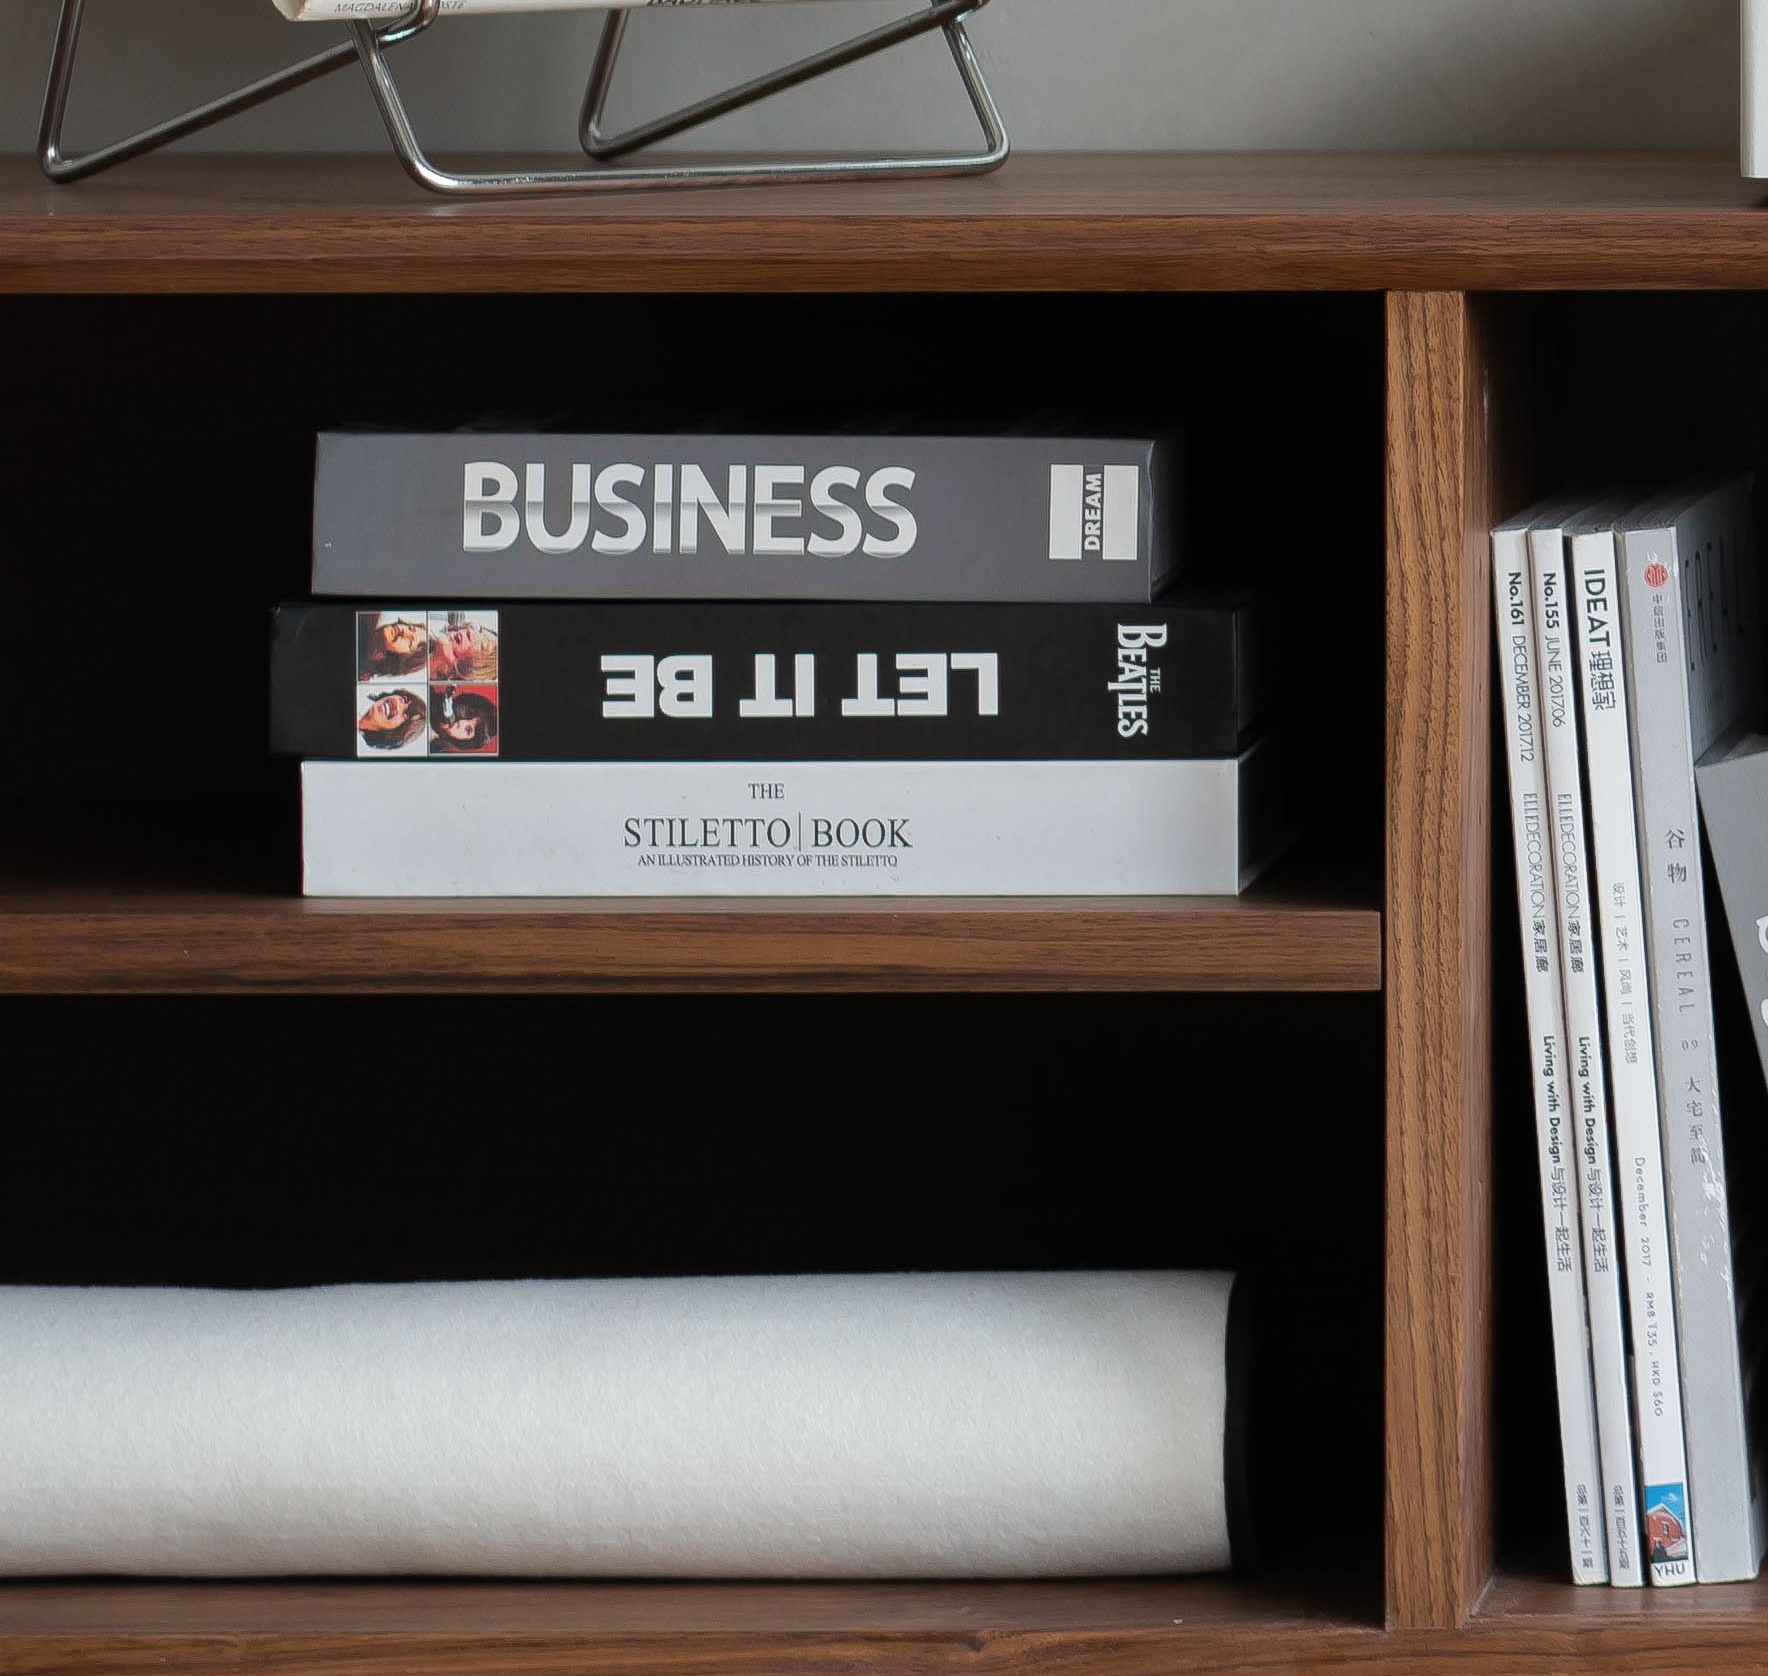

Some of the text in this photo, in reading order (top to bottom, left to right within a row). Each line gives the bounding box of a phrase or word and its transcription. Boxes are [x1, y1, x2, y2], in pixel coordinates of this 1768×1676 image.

[463, 461, 918, 558] BUSINESS
[1084, 473, 1101, 551] DREAM
[1508, 572, 1525, 625] No.161
[1543, 572, 1559, 629] No.155
[1544, 635, 1562, 671] JUNE
[1584, 569, 1616, 711] IDEAT 理想家
[601, 653, 998, 718] LET IT BE
[1107, 623, 1167, 738] BEATLES
[1150, 667, 1160, 693] THE
[1512, 635, 1530, 709] DECEMBER
[748, 783, 785, 799] THE
[624, 818, 912, 848] STILETTO BOOK
[638, 854, 897, 867] AN ILLUSTRATED HISTORY OF THE STILETTO
[1665, 829, 1687, 884] 谷物
[1612, 881, 1626, 908] 设计
[1615, 926, 1629, 952] 艺术
[1619, 969, 1632, 995] 风尚
[1672, 919, 1695, 1012] CEREAL
[1682, 1039, 1698, 1052] 09
[1543, 1036, 1572, 1273] Living with Design 与设计一起生活
[1578, 1036, 1609, 1274] Living with Design 与设计一起生活
[1635, 1157, 1647, 1227] December
[1641, 1237, 1652, 1266] 2017
[1646, 1292, 1655, 1319] RMB
[1651, 1360, 1661, 1387] HKD
[1652, 1391, 1663, 1417] $60
[1654, 1563, 1685, 1577] YHU
